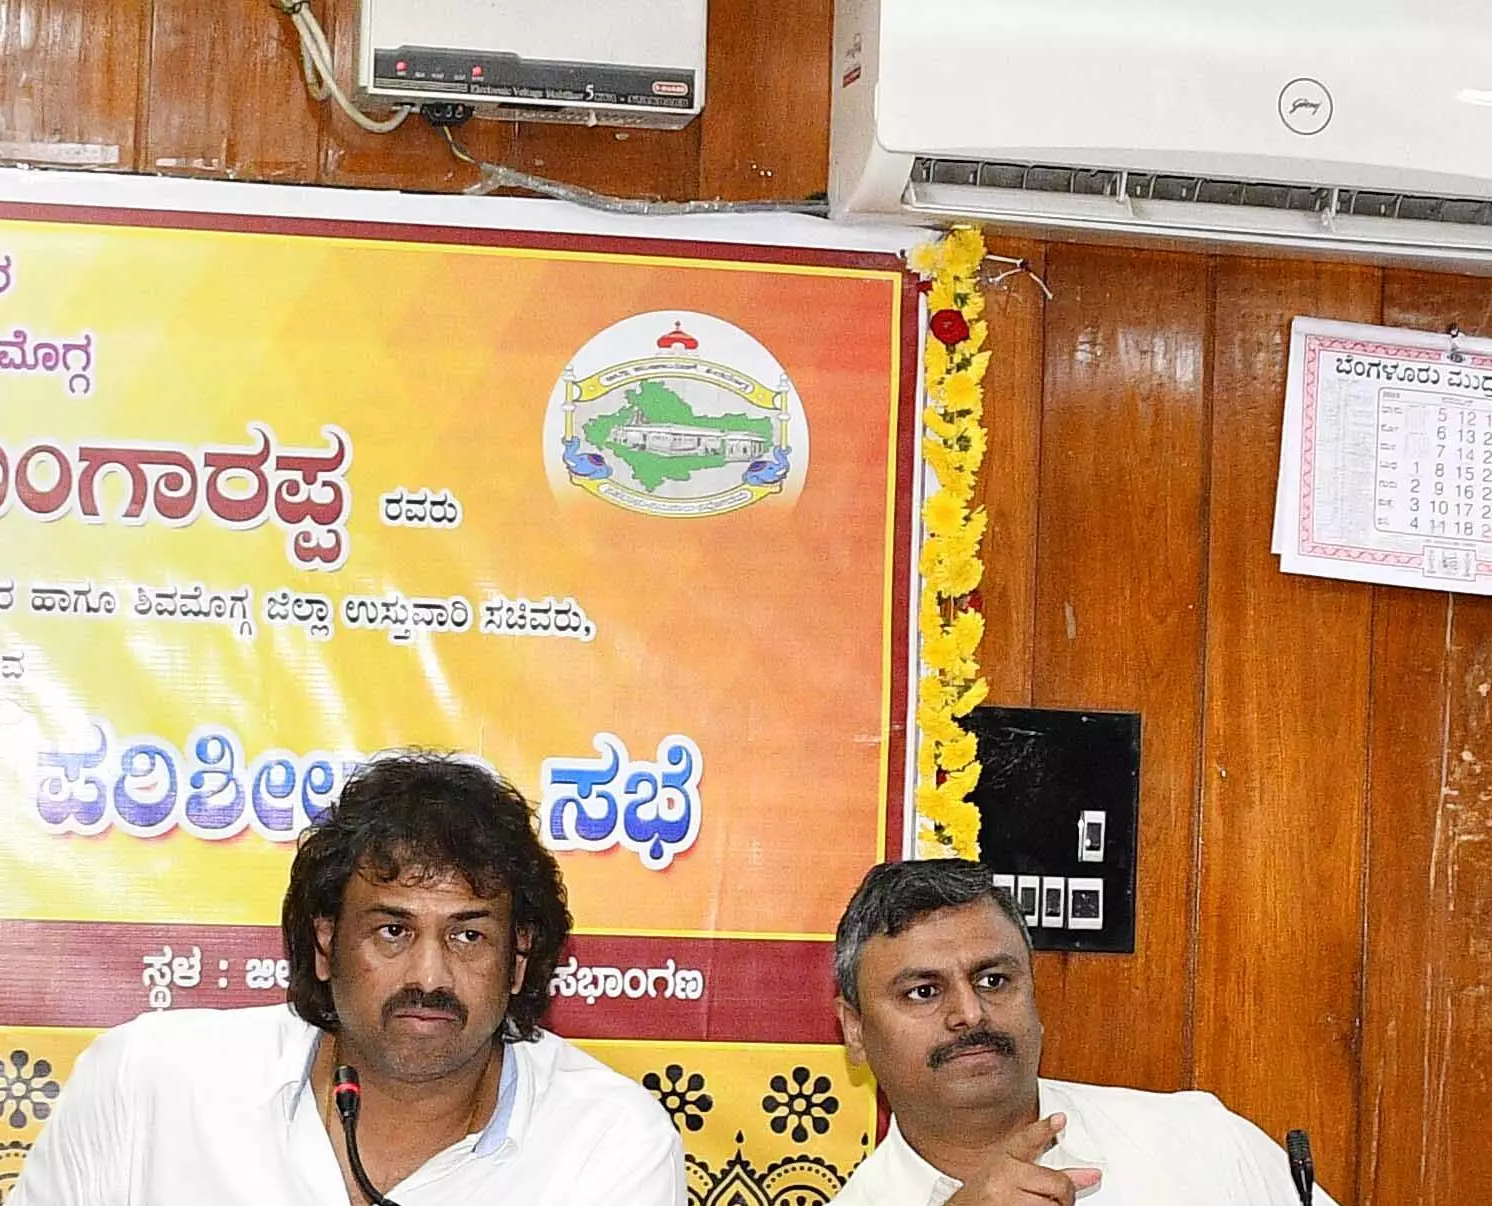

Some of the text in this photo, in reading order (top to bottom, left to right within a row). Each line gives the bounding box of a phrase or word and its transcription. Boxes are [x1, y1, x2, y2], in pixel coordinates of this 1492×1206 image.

[585, 83, 594, 100] 5
[1335, 354, 1441, 387] ಬೆಂಗಳೂರು
[1438, 408, 1448, 422] 5
[1459, 411, 1477, 426] 12
[1437, 426, 1446, 440] 6
[1458, 429, 1476, 444] 13
[1437, 444, 1446, 458] 7
[1458, 448, 1474, 461] 14
[1435, 462, 1444, 478] 8
[1457, 466, 1474, 481] 15
[1410, 479, 1420, 493] 2
[1434, 481, 1444, 496] 9
[1456, 484, 1474, 499] 16
[383, 490, 458, 525] ರವರು
[1410, 498, 1420, 512] 3
[1430, 500, 1448, 515] 10
[1456, 504, 1474, 517] 17
[1410, 516, 1419, 530] 4
[1430, 520, 1446, 534] 11
[1455, 522, 1474, 536] 18
[31, 584, 118, 615] ಹಾಗೂ
[133, 586, 252, 635] ಶಿವಮೊಗ್ಗ
[267, 591, 333, 636] ಜಿಲ್ಲಾ
[345, 596, 469, 641] ಉಸ್ತುವಾರಿ
[484, 600, 593, 637] ಸಚಿವರು,
[544, 738, 699, 862] ಸಭೆ
[141, 944, 202, 1012] ಸ್ಥಳ
[548, 955, 705, 1004] ಸಭಾಂಗಣ
